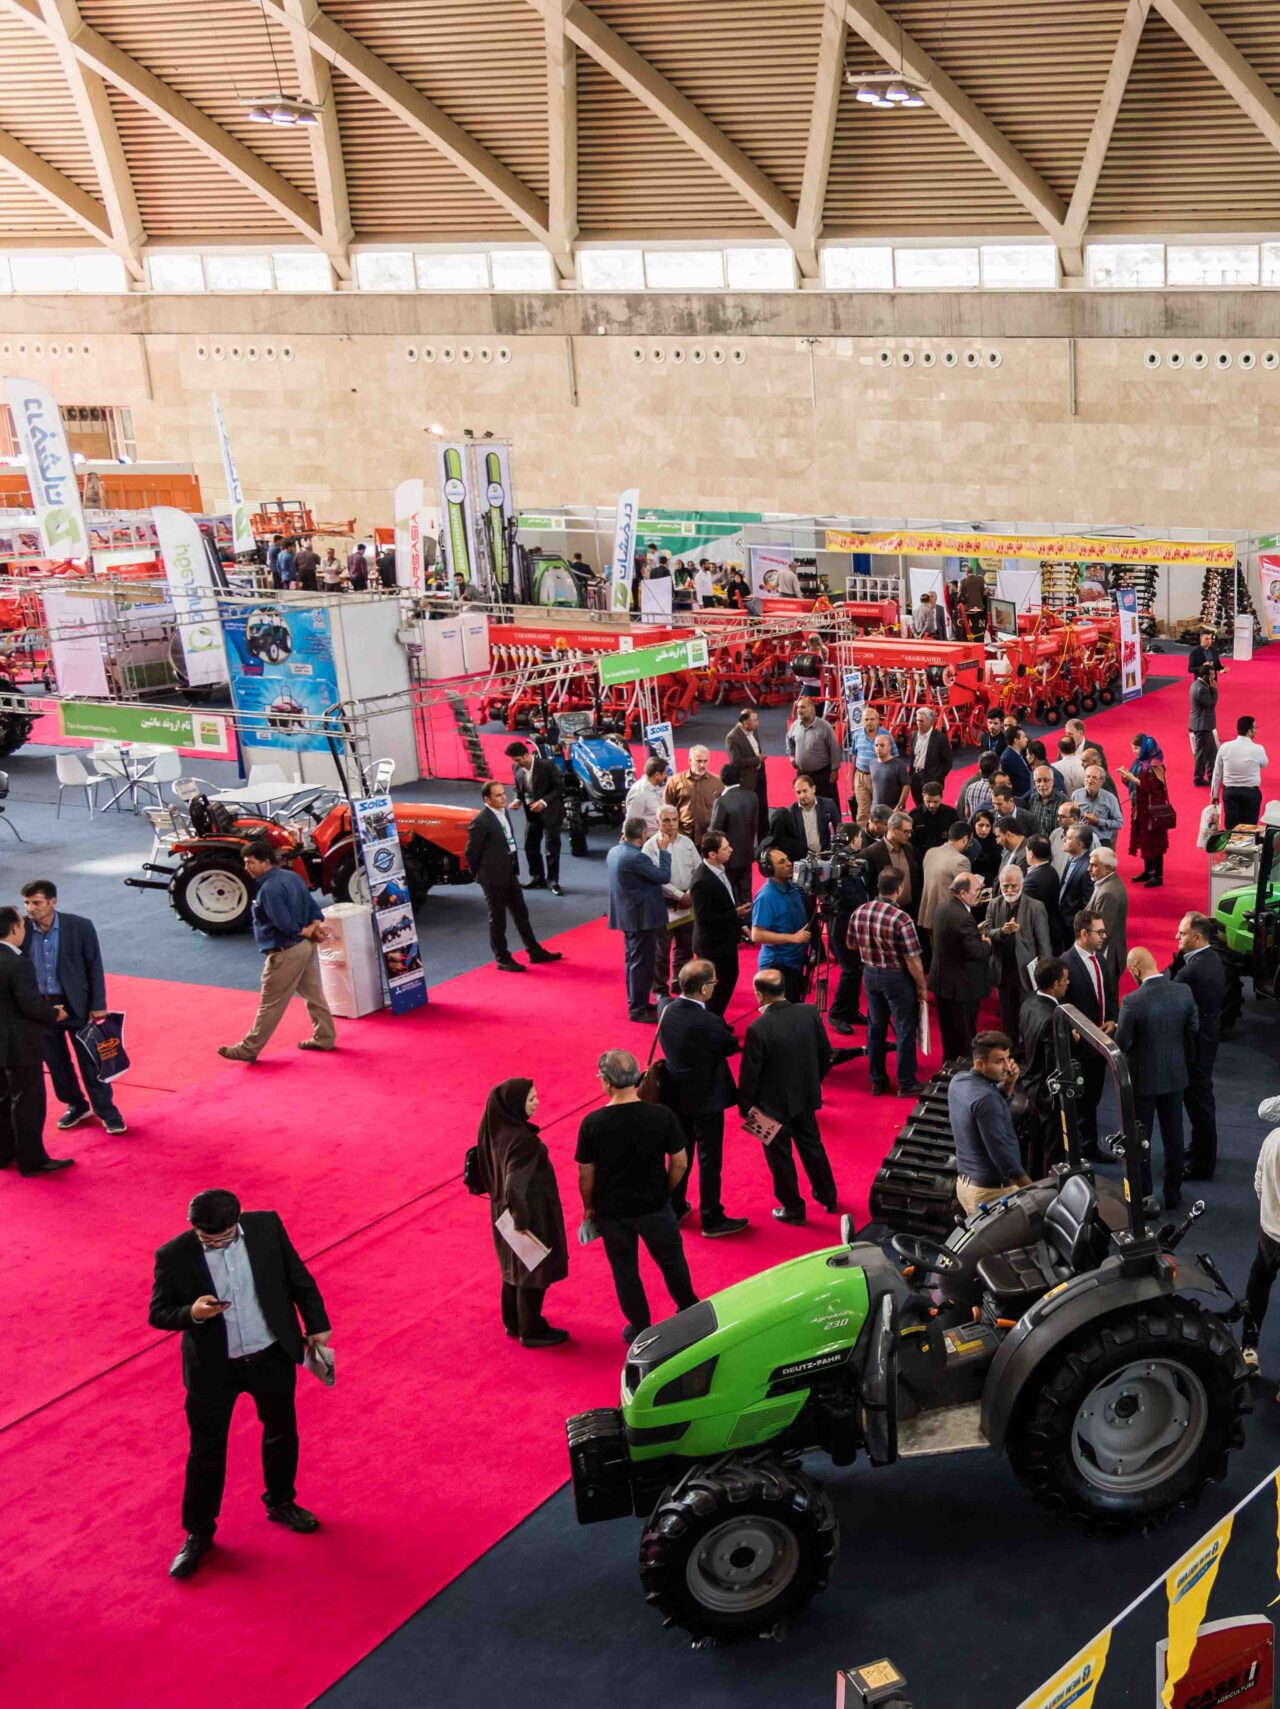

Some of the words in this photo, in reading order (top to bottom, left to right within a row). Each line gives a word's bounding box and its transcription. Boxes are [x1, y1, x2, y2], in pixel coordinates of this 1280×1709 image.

[617, 502, 633, 580] درخشان
[824, 1319, 849, 1331] 230
[782, 1354, 842, 1375] DEUTZ-FAHR
[1216, 1680, 1256, 1705] AGRICULTURE
